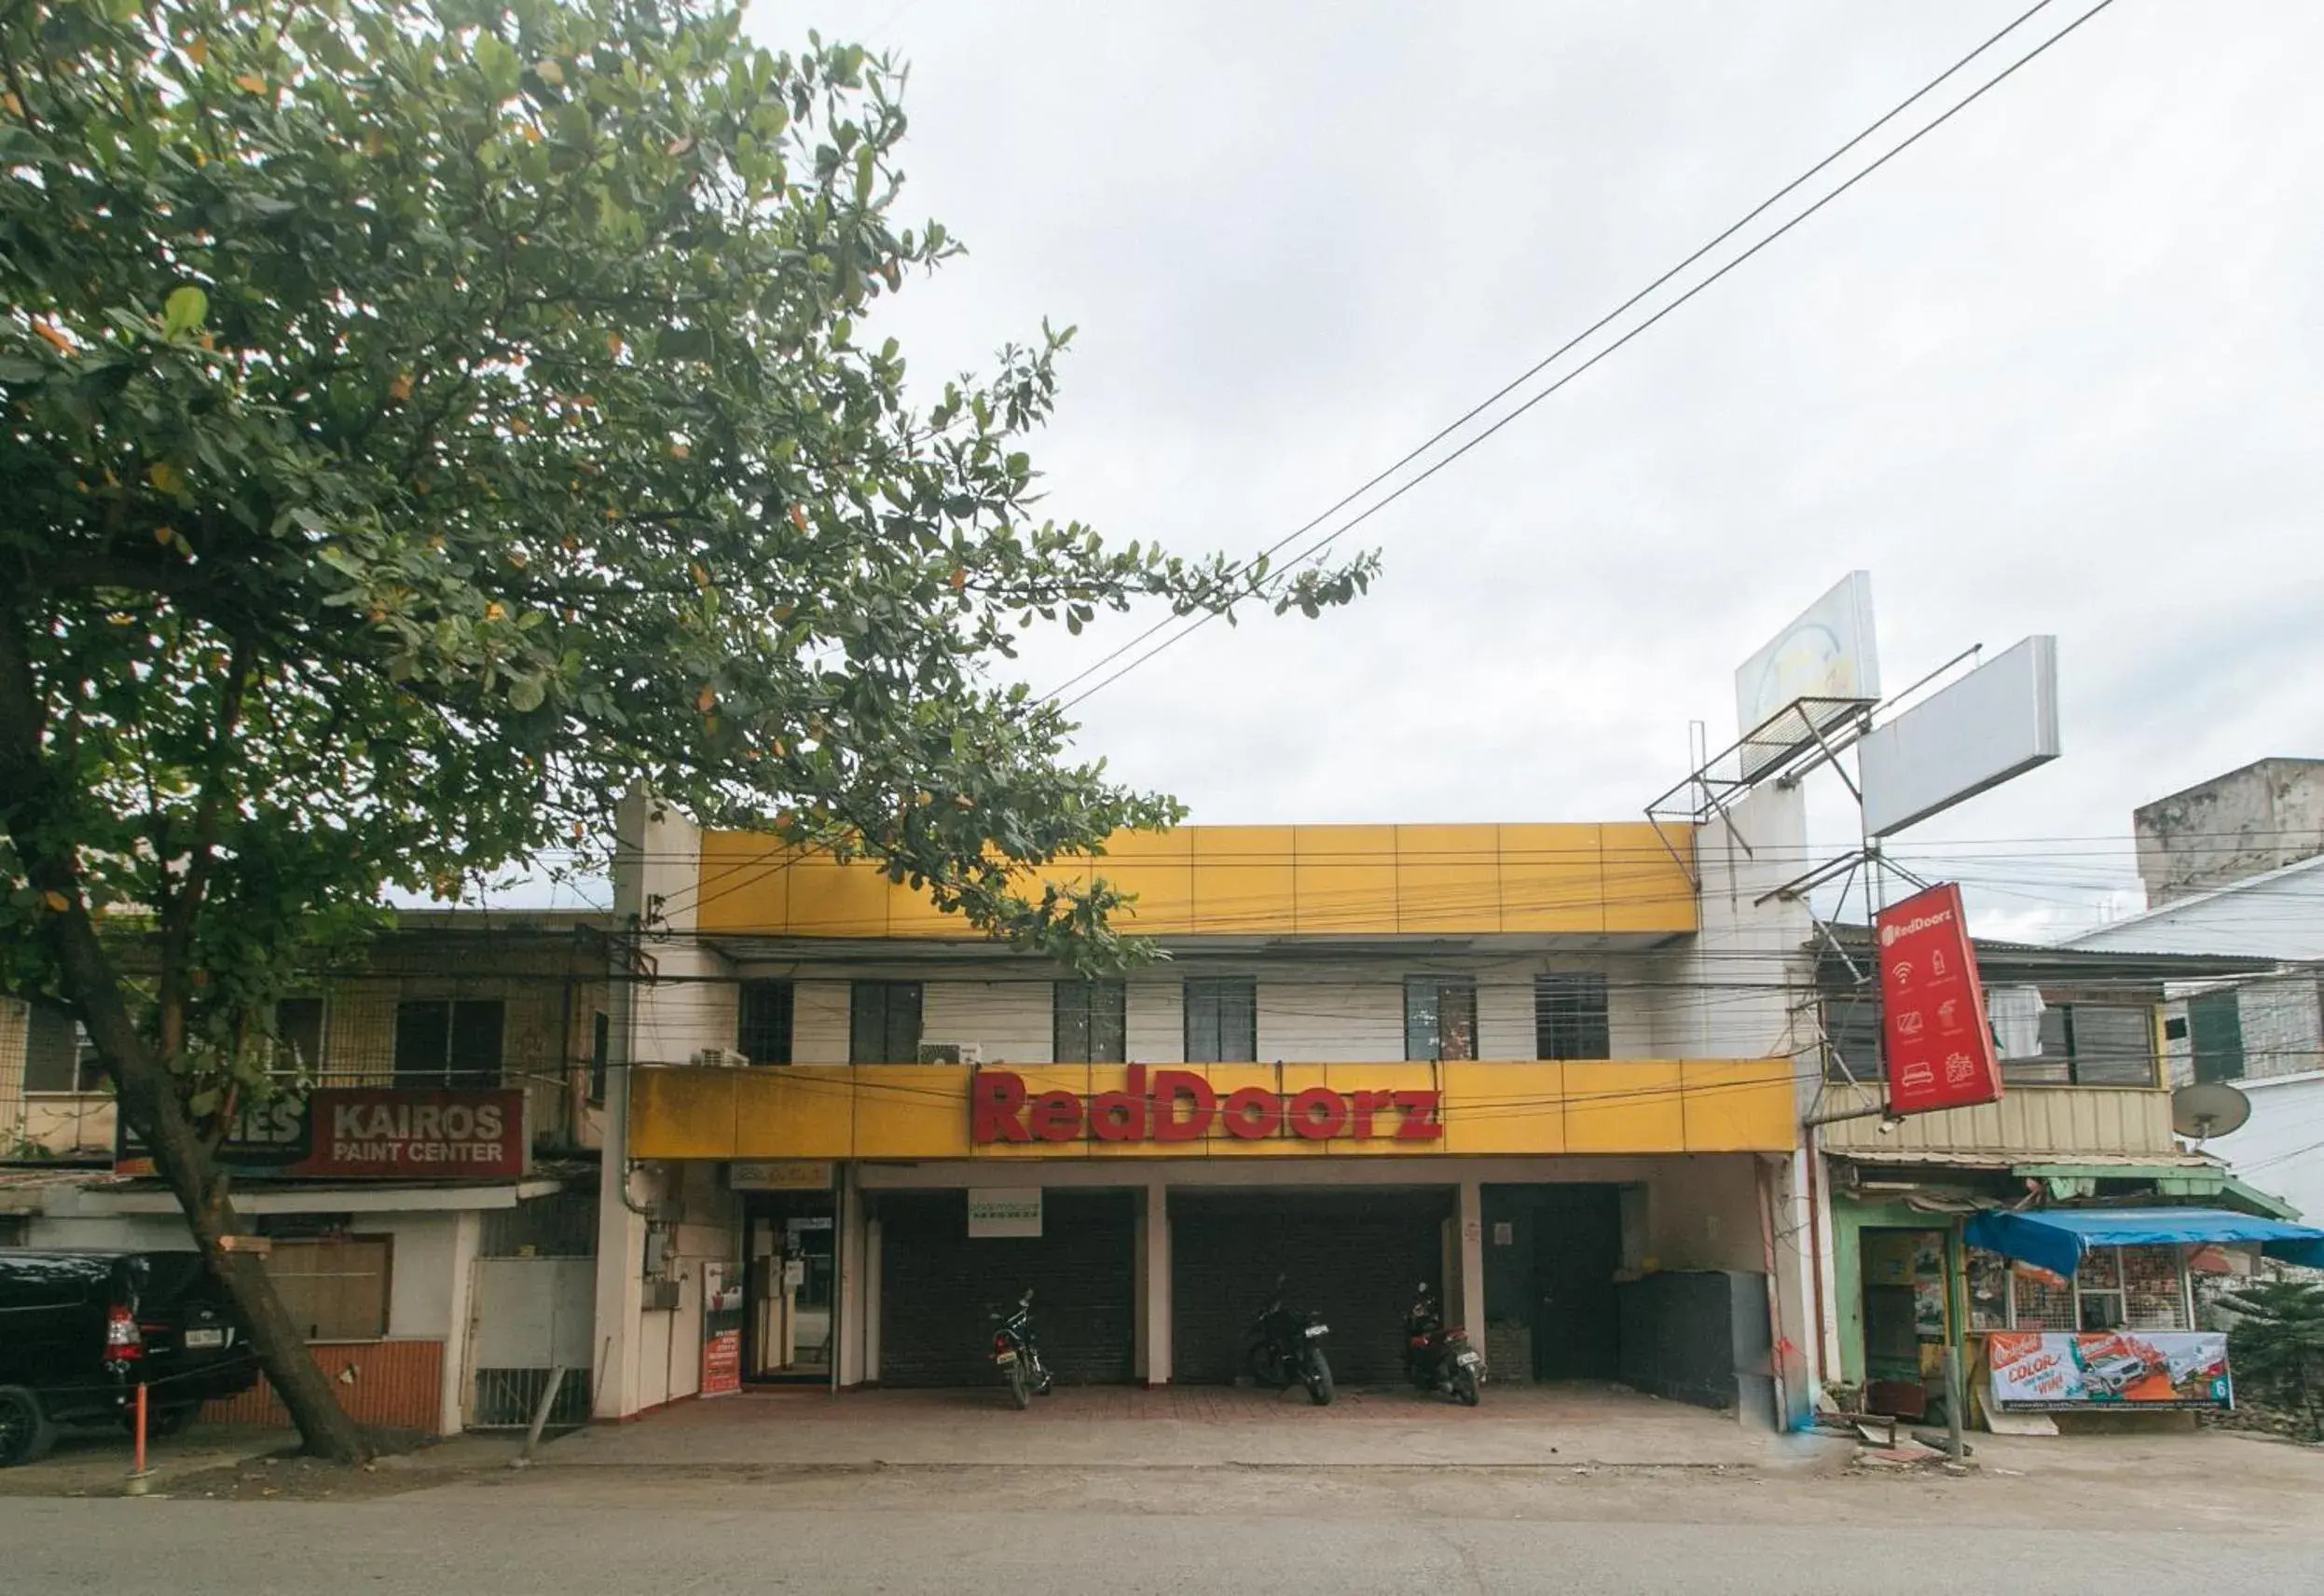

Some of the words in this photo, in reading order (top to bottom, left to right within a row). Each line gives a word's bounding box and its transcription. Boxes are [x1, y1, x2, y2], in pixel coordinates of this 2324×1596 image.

[975, 1064, 1443, 1143] RedDoorz
[333, 1104, 503, 1140] KAIROS
[333, 1142, 404, 1162] PAINT
[407, 1142, 503, 1163] CENTER
